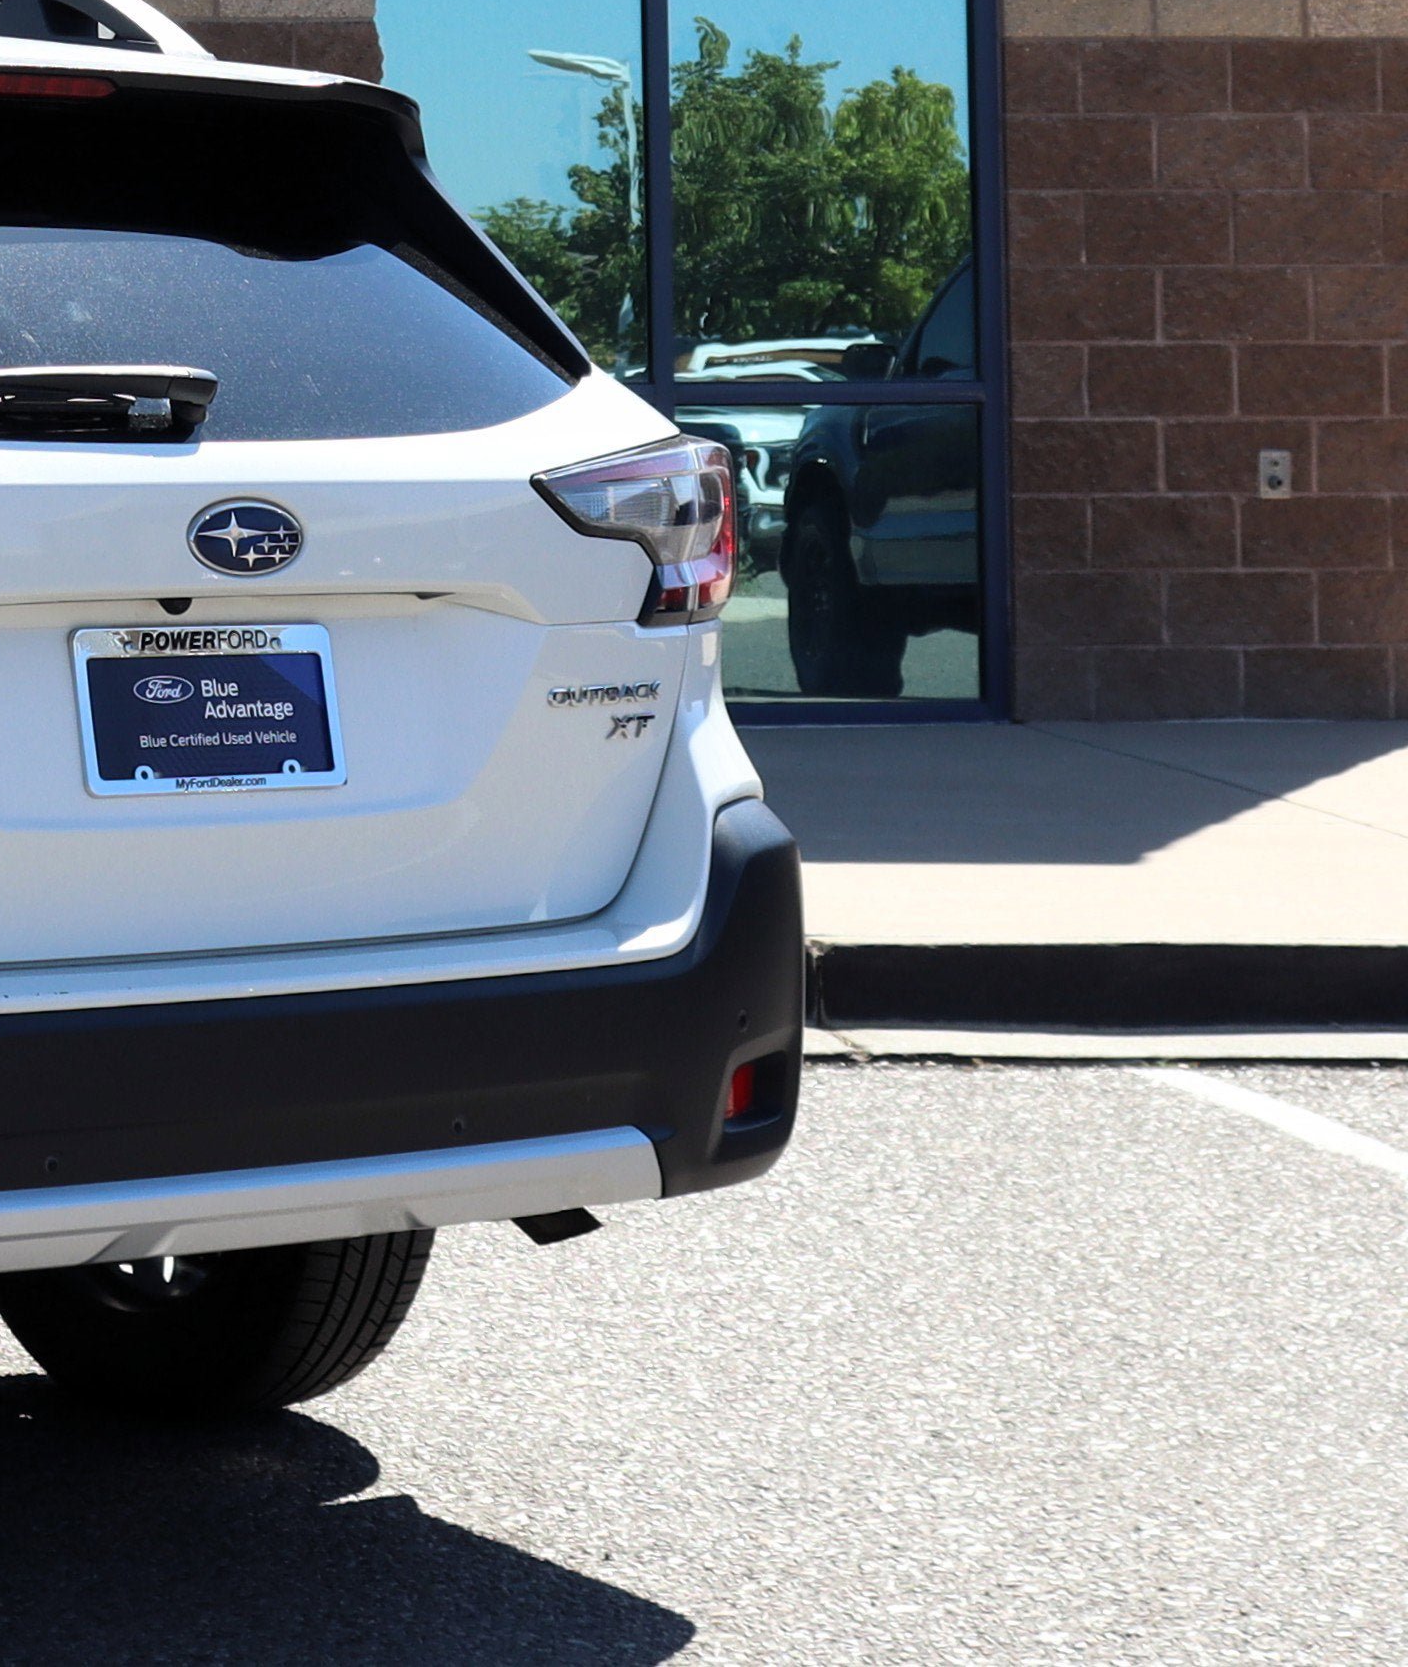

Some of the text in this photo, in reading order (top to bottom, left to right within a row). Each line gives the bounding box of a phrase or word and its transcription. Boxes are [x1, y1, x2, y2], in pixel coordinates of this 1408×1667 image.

[144, 678, 183, 700] Ford
[200, 678, 239, 698] Blue
[547, 679, 661, 709] OUTBACK
[204, 700, 294, 721] Advantage
[605, 709, 656, 740] XT
[139, 730, 297, 749] Blue Certified Used Vehicle
